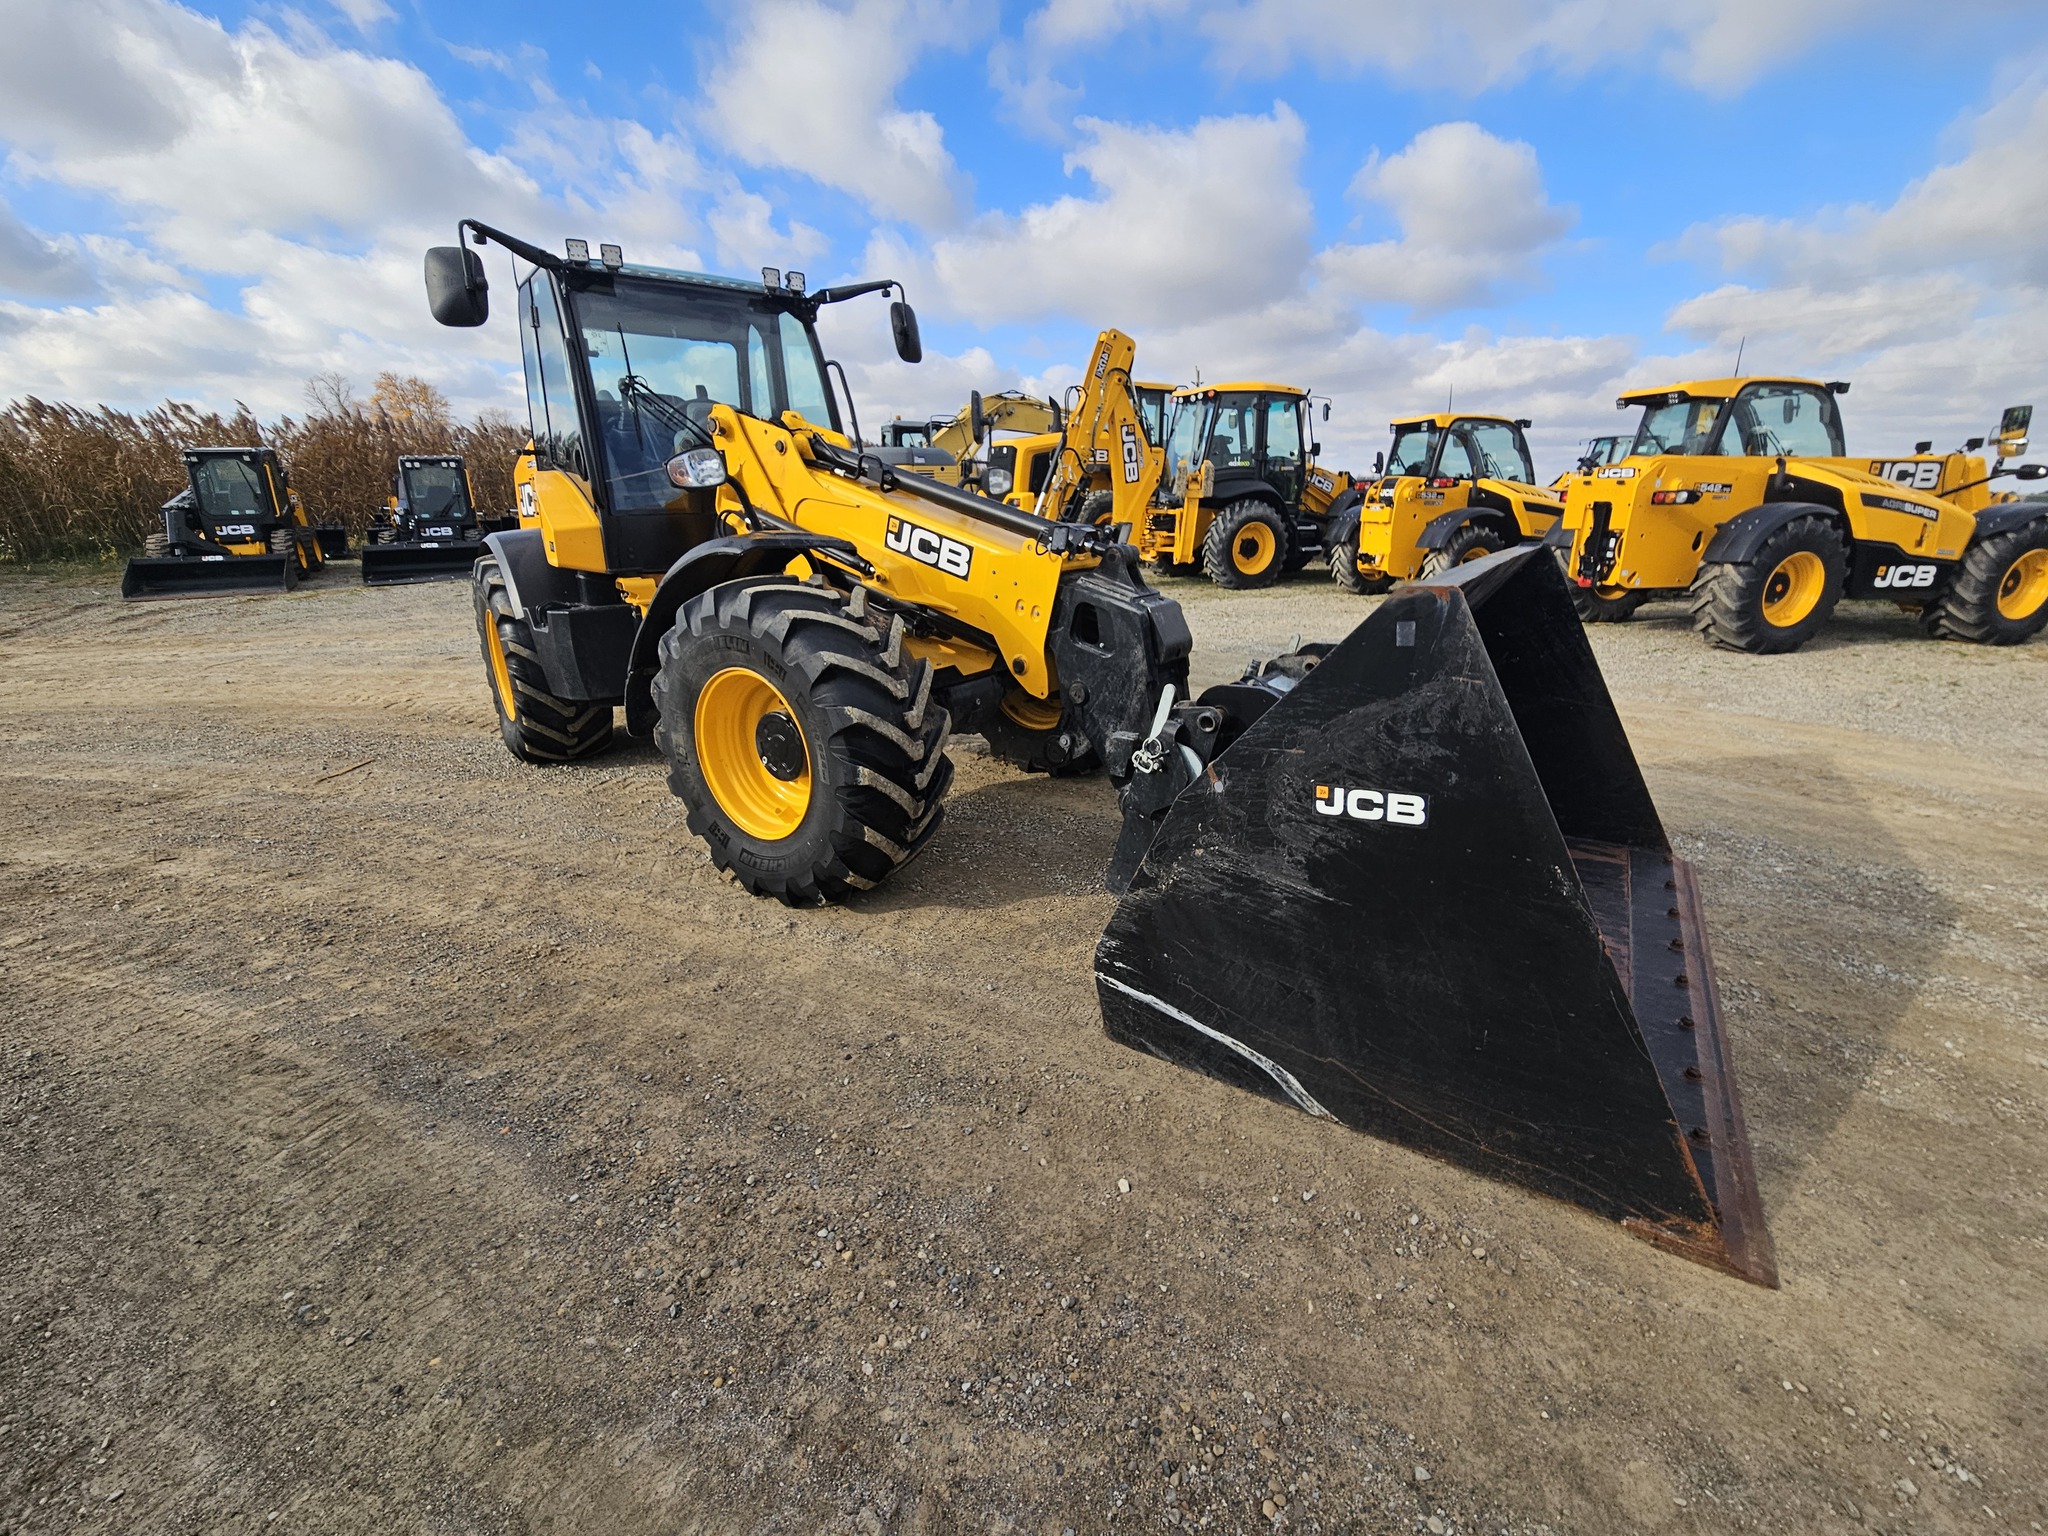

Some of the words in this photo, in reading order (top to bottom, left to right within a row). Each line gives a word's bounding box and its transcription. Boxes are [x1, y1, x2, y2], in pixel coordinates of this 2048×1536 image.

[1121, 425, 1139, 483] JCB
[1598, 468, 1635, 478] JCB
[519, 483, 536, 516] JC
[215, 525, 256, 536] JCB
[420, 527, 453, 537] JCB
[886, 518, 971, 577] JCB
[1873, 565, 1937, 588] JCB
[1315, 786, 1426, 825] JCB
